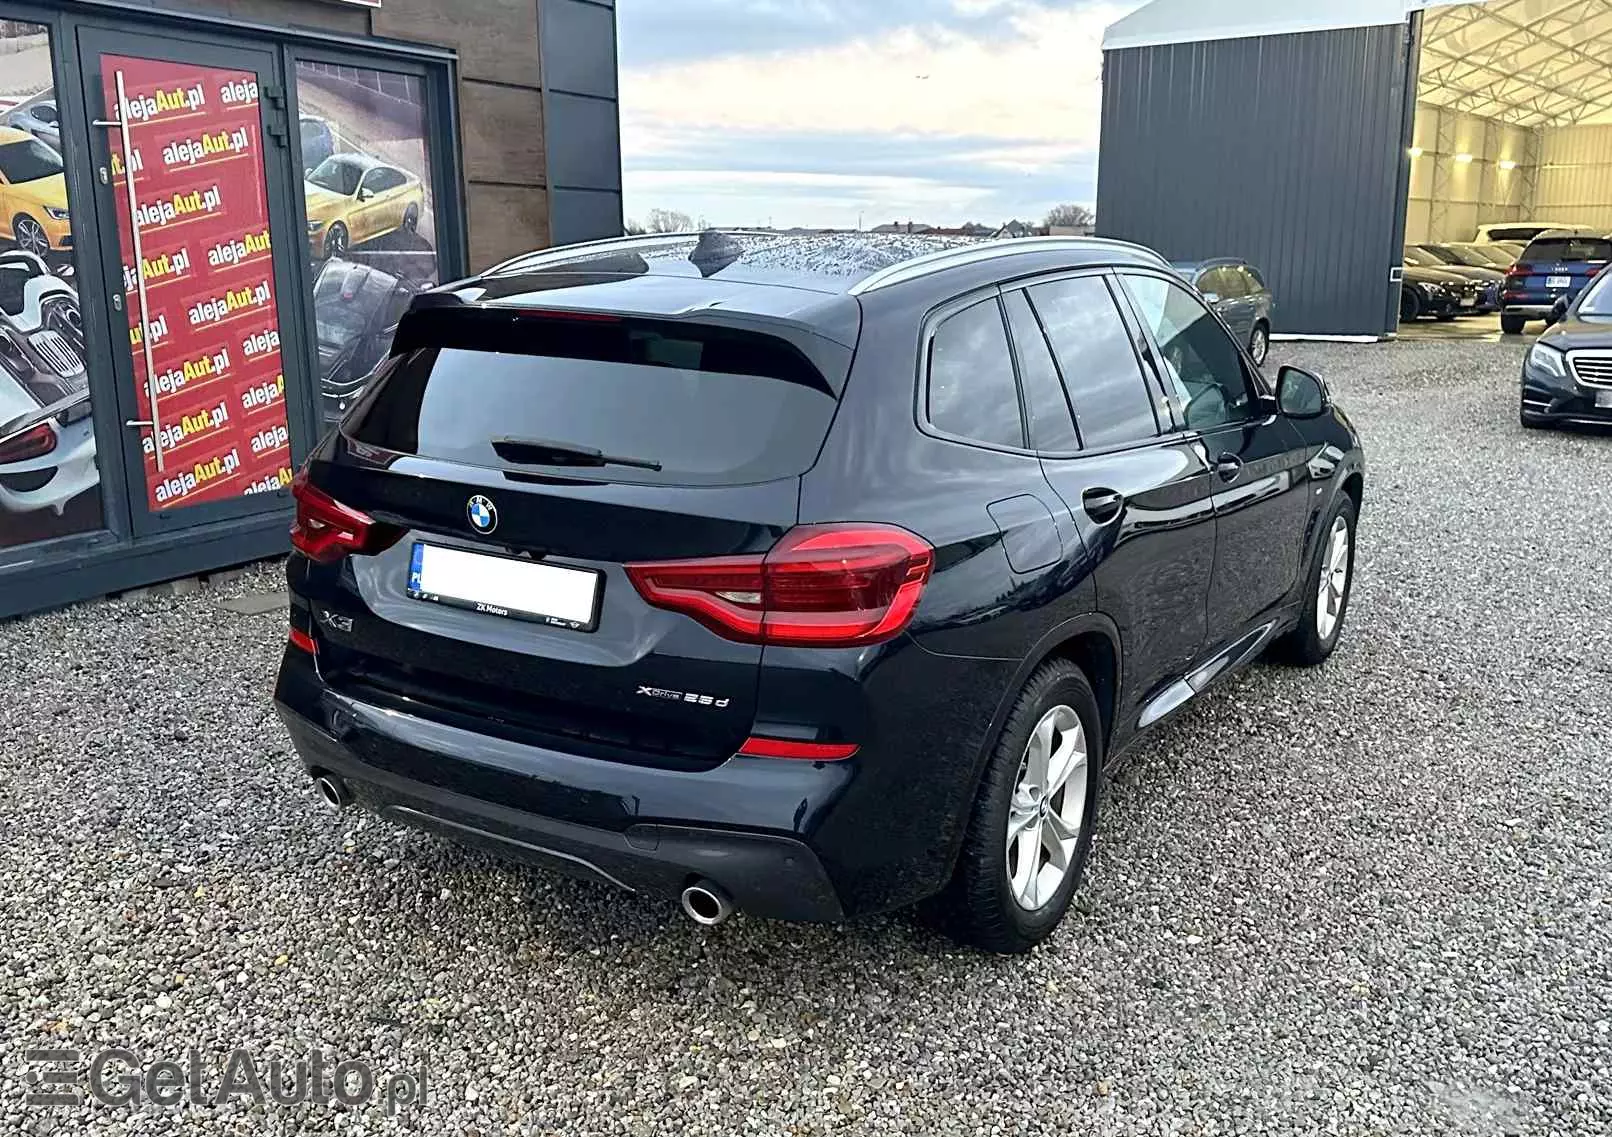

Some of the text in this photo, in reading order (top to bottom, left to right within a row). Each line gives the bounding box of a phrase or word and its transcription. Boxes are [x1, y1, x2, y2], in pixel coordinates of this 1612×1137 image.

[220, 79, 258, 104] aleja
[162, 126, 249, 165] alejaAut.pl
[188, 280, 271, 325] alejaAut.pl
[242, 329, 280, 356] aleja
[142, 402, 228, 453] aejaAut.pl
[155, 448, 240, 502] alejaAut.pl
